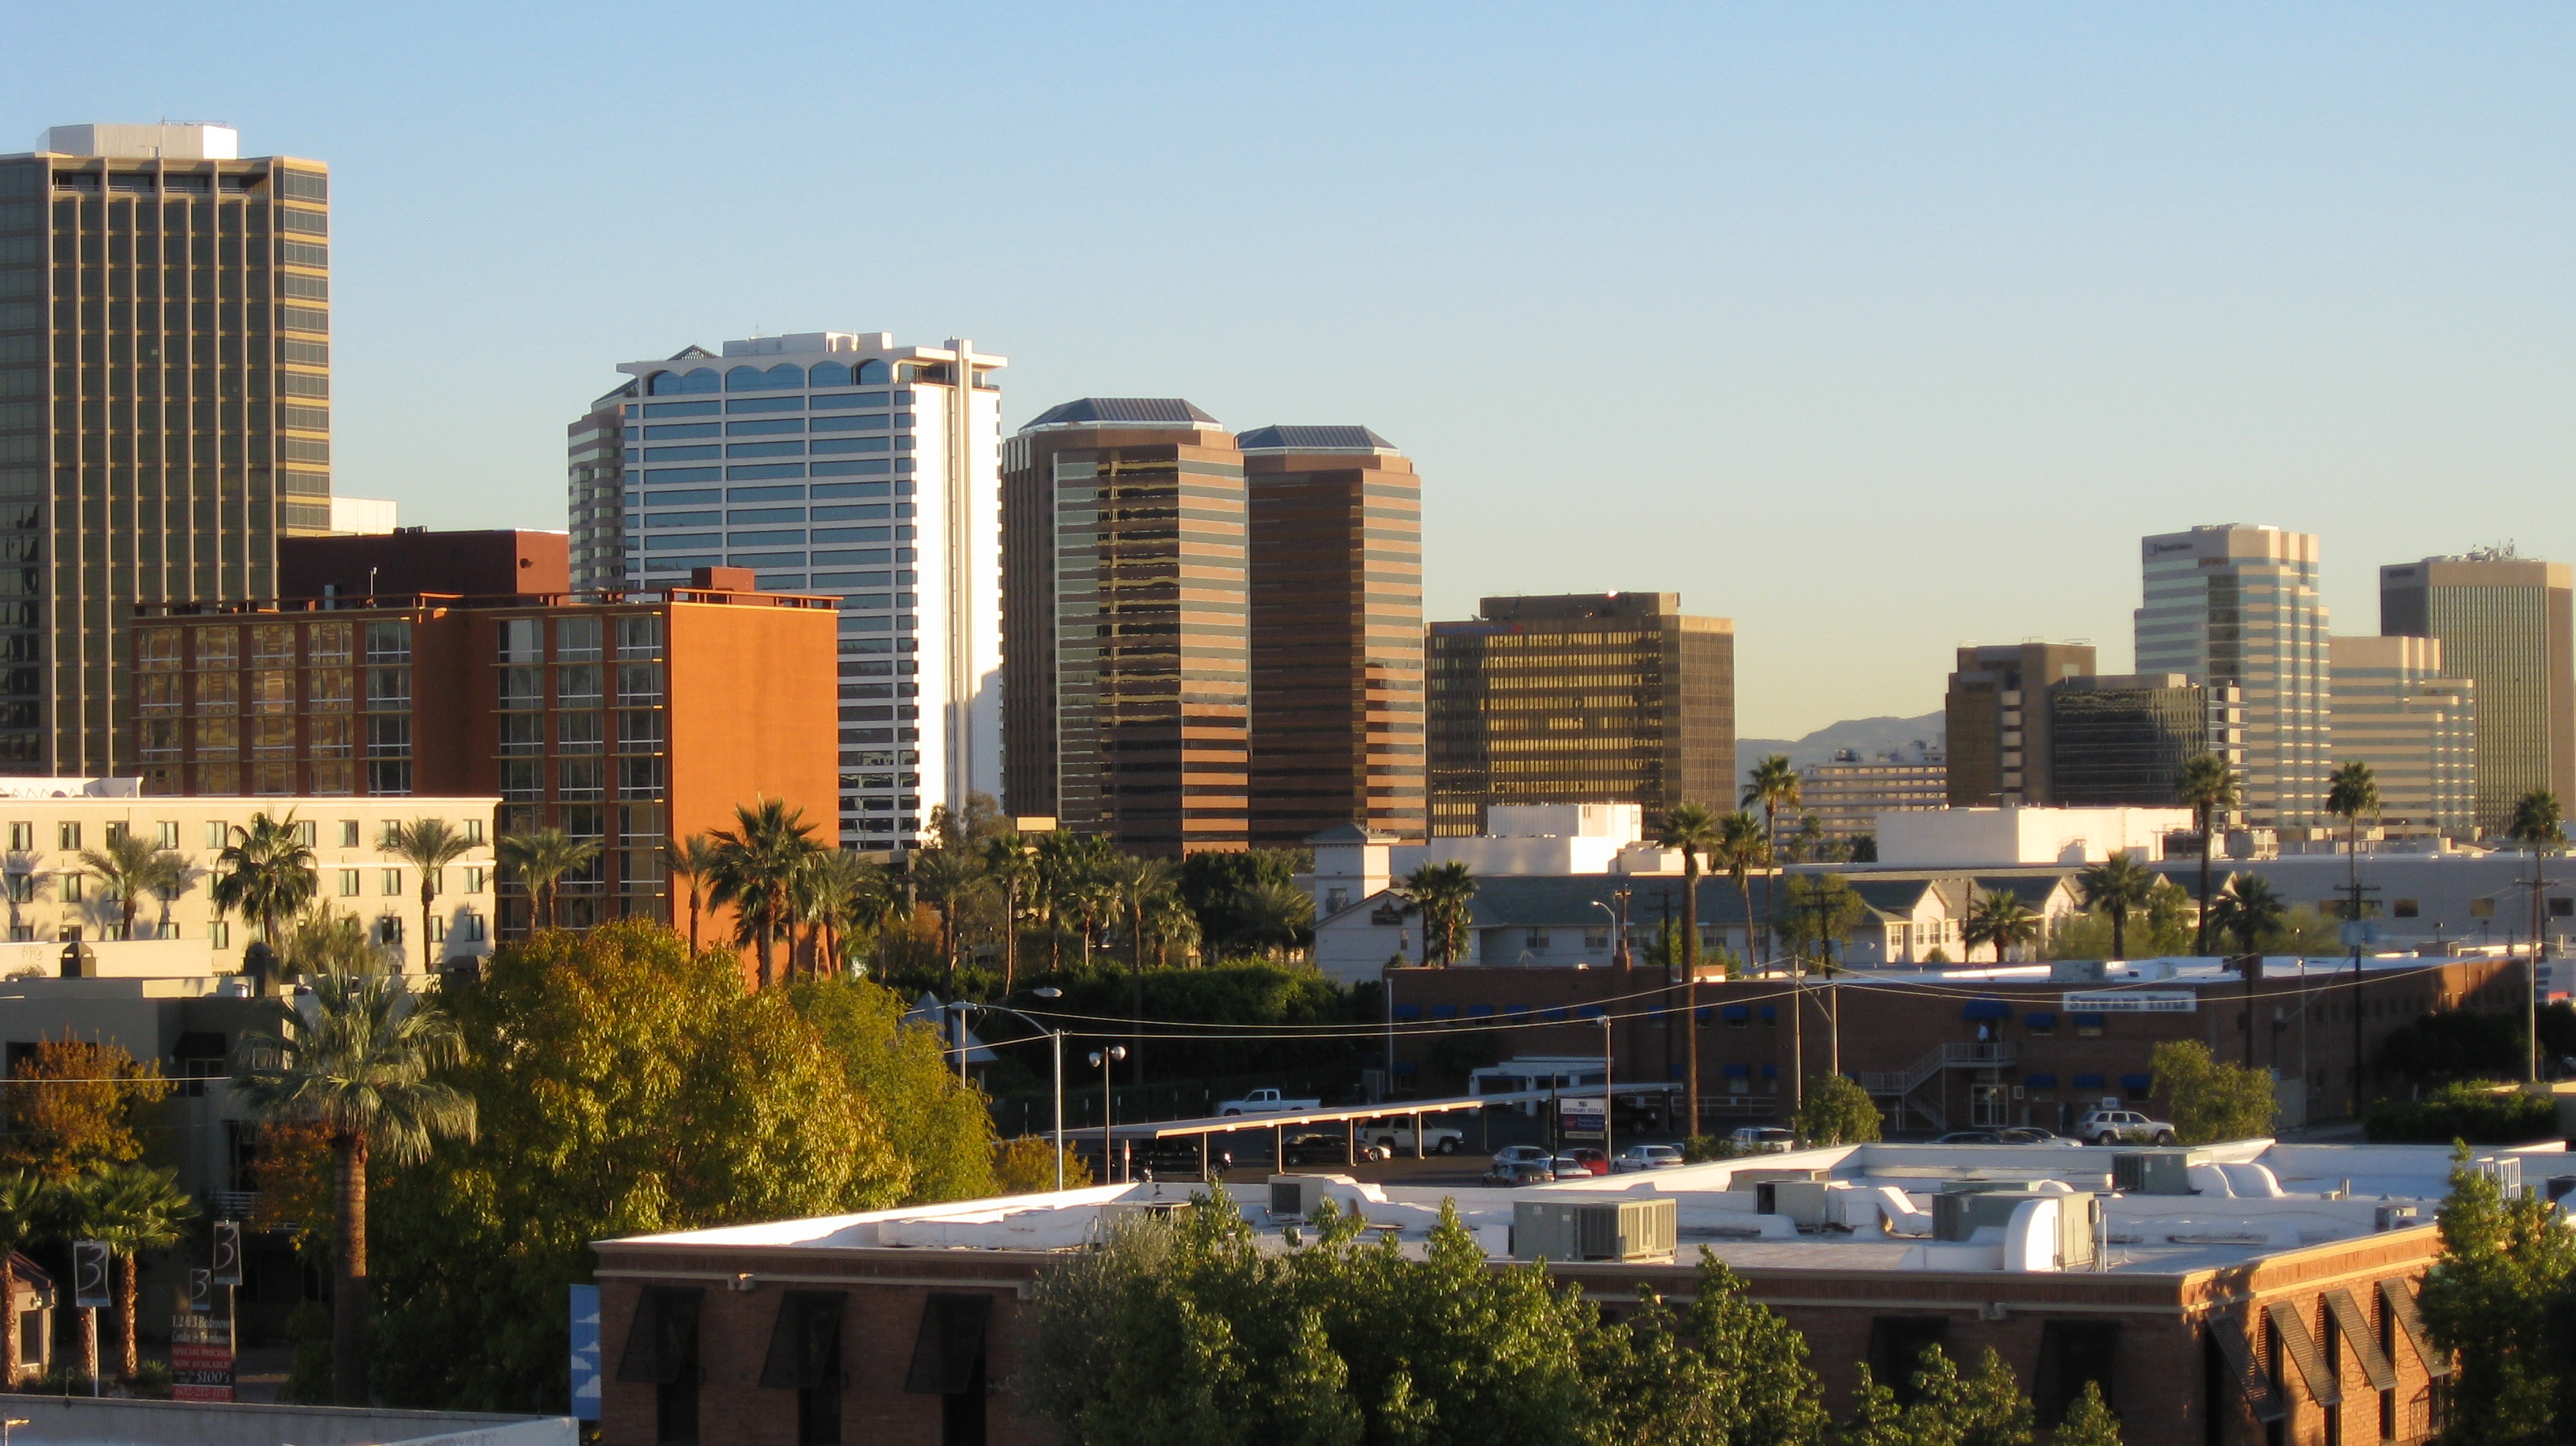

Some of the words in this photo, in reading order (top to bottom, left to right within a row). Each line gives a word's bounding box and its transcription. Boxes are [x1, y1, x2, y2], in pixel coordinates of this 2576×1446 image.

[78, 1246, 106, 1291] 3
[214, 1226, 237, 1269] 3
[191, 1269, 210, 1299] 3
